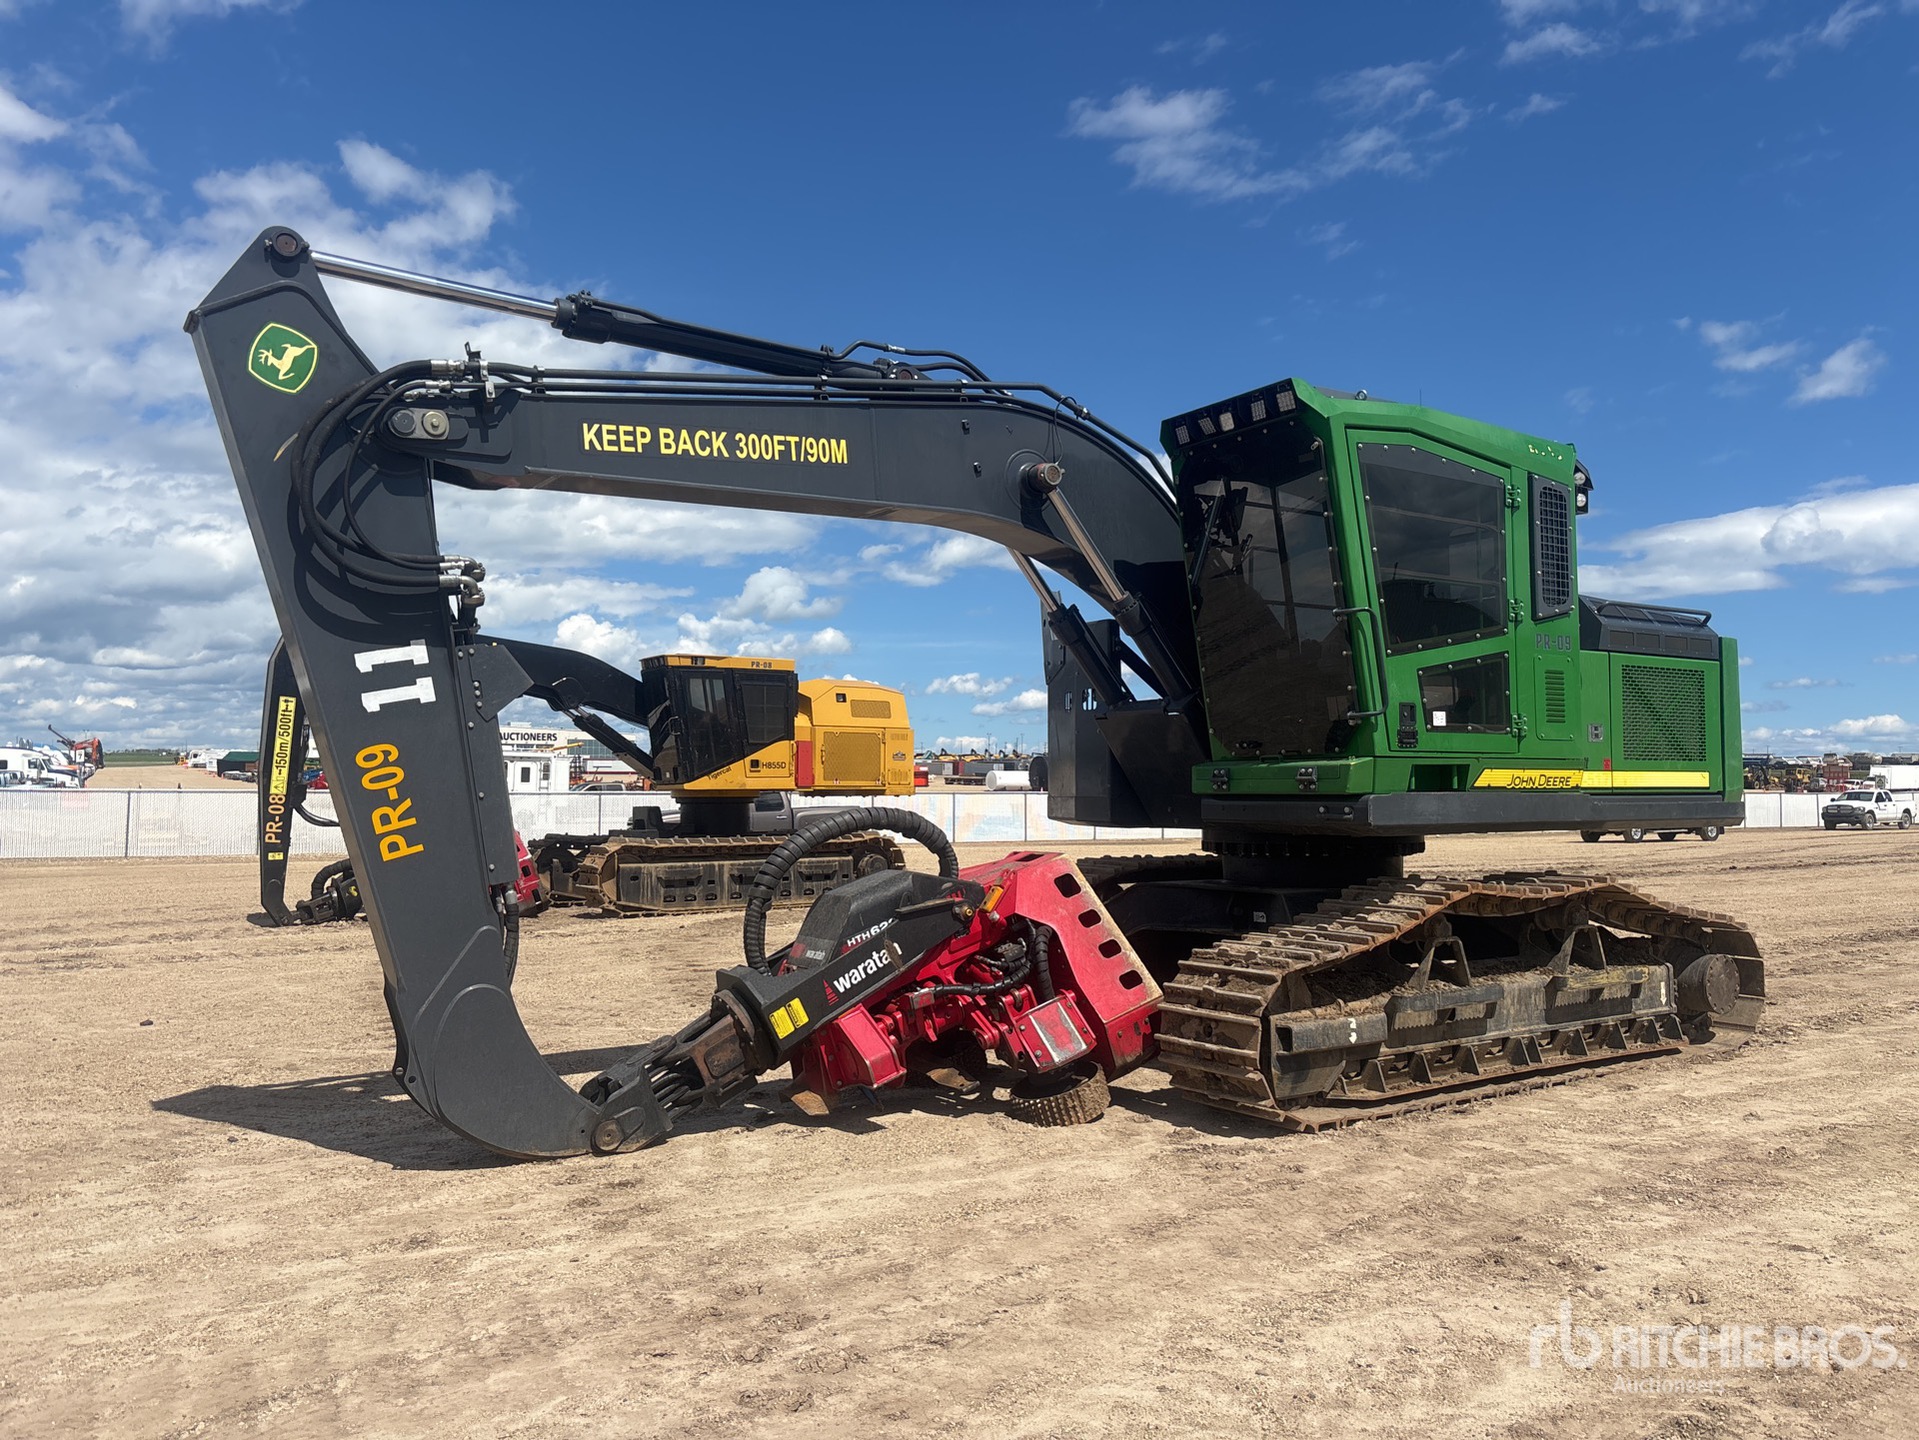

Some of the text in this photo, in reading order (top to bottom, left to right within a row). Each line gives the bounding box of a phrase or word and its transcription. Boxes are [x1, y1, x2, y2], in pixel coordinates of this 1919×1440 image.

[582, 422, 849, 464] KEEP BACK 300FT/90M
[1535, 632, 1572, 651] PR-09
[751, 660, 773, 669] PR-08
[354, 638, 436, 713] 11
[500, 732, 558, 742] AUCTIONEERS
[707, 766, 732, 780] Tigercat
[762, 761, 787, 770] H855D
[1507, 774, 1572, 787] JOHN DEERE
[355, 743, 424, 862] PR-09
[265, 794, 286, 843] PR-08
[847, 918, 893, 947] HTH62
